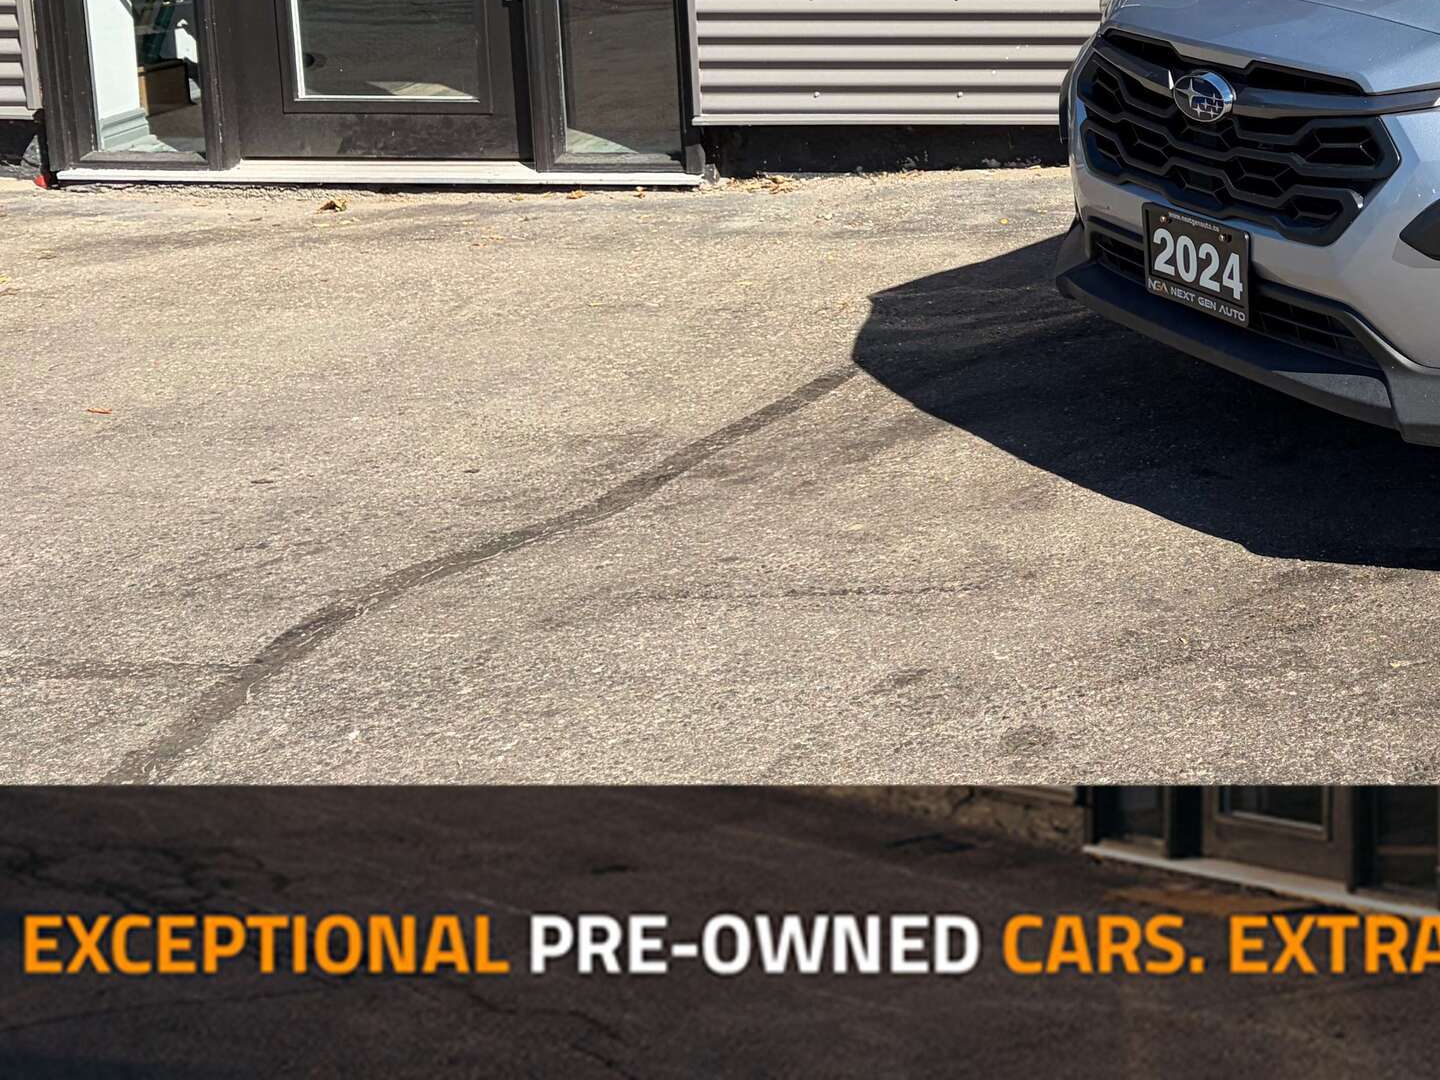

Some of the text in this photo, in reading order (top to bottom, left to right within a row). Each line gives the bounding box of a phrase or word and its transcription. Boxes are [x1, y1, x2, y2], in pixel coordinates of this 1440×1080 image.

[1153, 228, 1243, 300] 2024
[1170, 287, 1196, 302] NEXT
[1198, 296, 1217, 311] GEN
[1218, 305, 1246, 322] AUTO
